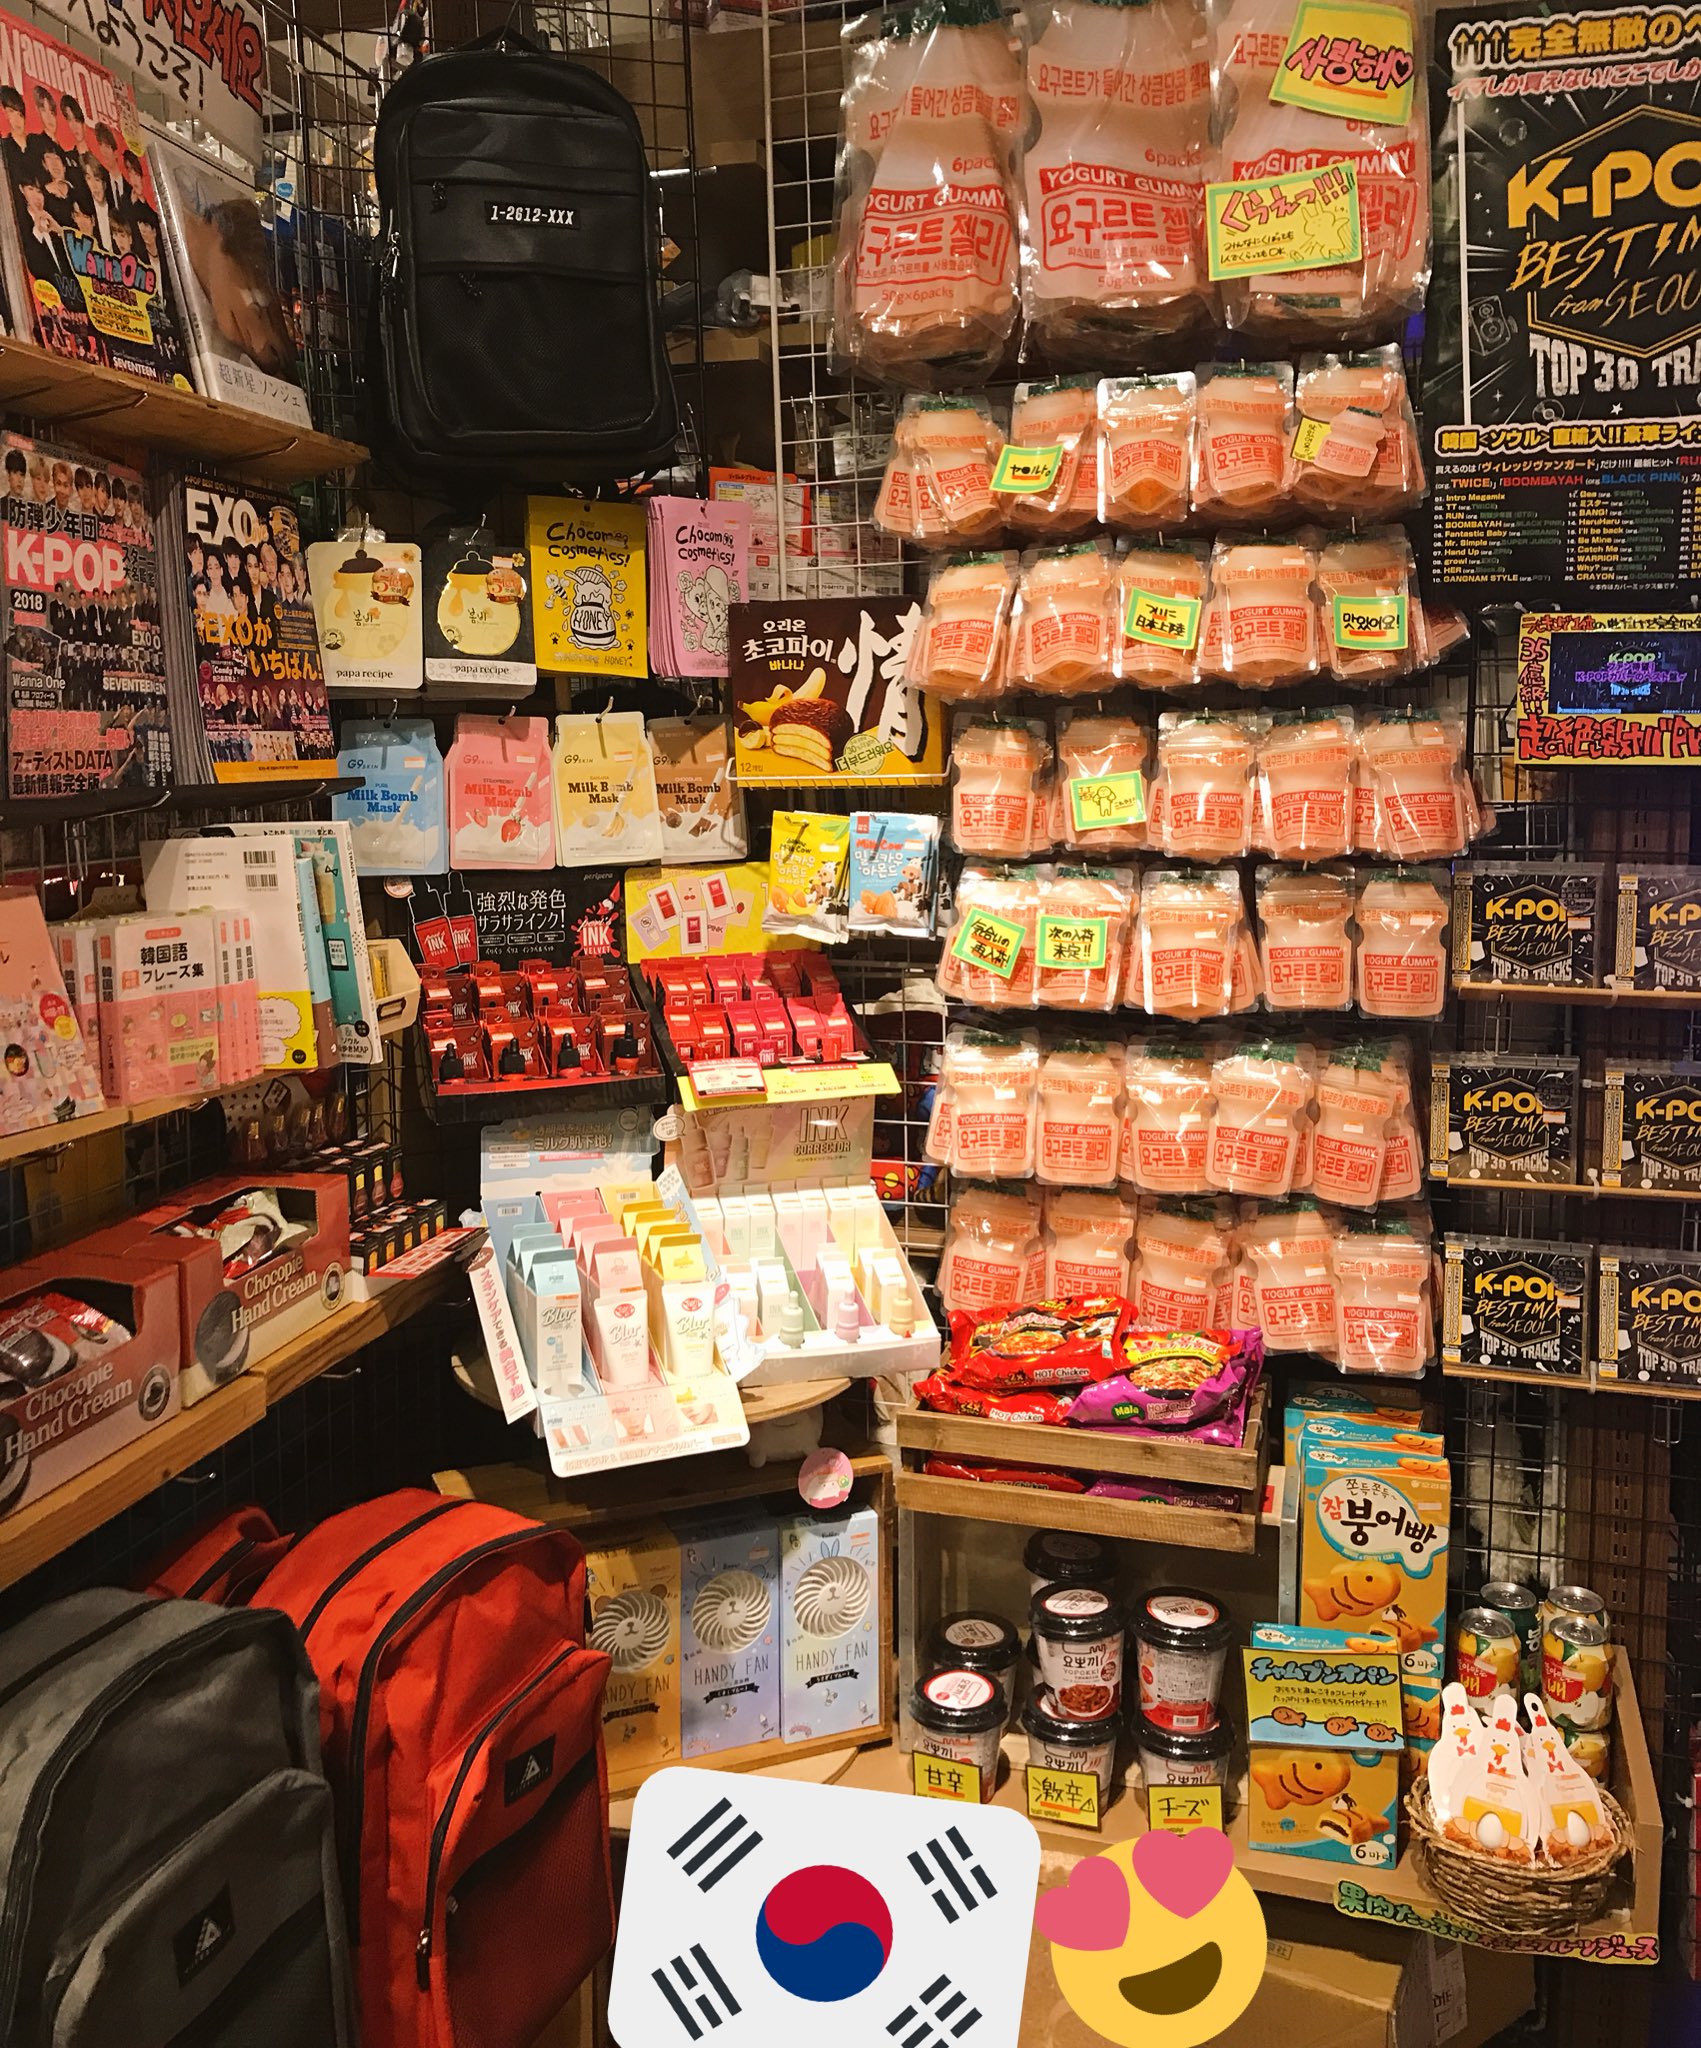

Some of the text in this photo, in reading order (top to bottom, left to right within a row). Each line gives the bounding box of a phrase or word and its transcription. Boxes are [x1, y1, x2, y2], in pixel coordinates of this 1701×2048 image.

[1046, 168, 1128, 190] YOGURT
[934, 186, 1006, 210] GUMMY
[490, 204, 574, 225] 1-2612-XXX
[1050, 197, 1155, 247] 요구르트
[950, 212, 1000, 268] 젤리
[1506, 223, 1658, 292] BEST
[1550, 294, 1600, 318] from
[112, 356, 157, 378] SEVENTEEN
[1529, 332, 1588, 398] TOP
[1593, 349, 1639, 392] 30
[9, 498, 98, 543] 防弾少年団
[7, 529, 127, 595] K-POP
[14, 591, 43, 611] 2018
[573, 609, 613, 631] HONEY
[1233, 606, 1305, 618] YOGURT GUMMY
[763, 618, 807, 635] 오리온
[1234, 619, 1305, 644] 요구르트 젤리
[742, 636, 834, 663] 초코파이
[249, 650, 323, 681] いちばん!
[336, 669, 394, 679] papa recipe
[454, 664, 510, 675] papa recipe
[769, 658, 806, 672] 바나나
[12, 673, 66, 690] Wanna One
[12, 750, 114, 772] アーティストDATA
[347, 789, 418, 802] Milk Bomb
[464, 783, 496, 796] Milk
[567, 781, 598, 793] Milk
[656, 782, 721, 794] Milk Bomb
[367, 801, 401, 814] Mask
[484, 796, 517, 809] Mask
[588, 793, 620, 804] Mask
[675, 794, 706, 805] Mask
[476, 889, 566, 913] 強烈な発色
[478, 908, 566, 934] サラサラインク!
[582, 925, 610, 946] INK
[1485, 923, 1528, 941] BEST
[140, 942, 189, 966] 韓国語
[1272, 948, 1341, 958] YOGURT GUMMY
[1518, 941, 1564, 957] SEOUL
[1401, 957, 1435, 966] GUMMY
[1490, 957, 1572, 981] TOP 30 TRACKS
[143, 962, 205, 984] フレーズ集
[1273, 963, 1340, 983] 요구르트 젤리
[1367, 972, 1434, 993] 요구르트 젤리
[801, 1104, 849, 1141] INK
[961, 1114, 1026, 1124] YOGURT GUMMY
[1463, 1115, 1507, 1134] BEST
[793, 1141, 851, 1154] CORRECTOR
[960, 1128, 1025, 1150] 요구르트 젤리
[1495, 1133, 1542, 1148] SEOUL
[1469, 1147, 1549, 1172] TOP 30 TRACKS
[243, 1252, 304, 1300] Chocopie
[955, 1256, 1018, 1276] YOGURT GUMMY
[953, 1273, 1016, 1299] 요구르트 젤리
[230, 1270, 318, 1334] Hand Cream
[1474, 1299, 1524, 1318] BEST
[541, 1306, 576, 1328] Blur
[677, 1315, 709, 1336] Blur
[1507, 1318, 1553, 1335] SEOUL
[609, 1324, 642, 1345] Blur
[1479, 1332, 1561, 1362] TOP 30 TRACKS
[1033, 1366, 1091, 1379] HOT Chicken
[25, 1360, 114, 1421] Chocopie
[4, 1377, 133, 1464] Hand Cream
[989, 1408, 1045, 1422] HOT Chicken
[1114, 1404, 1140, 1416] Mala
[1322, 1495, 1344, 1521] 참
[1340, 1498, 1437, 1554] 붕어빵
[796, 1641, 869, 1672] HANDY FAN
[1063, 1655, 1099, 1667] 요뽀끼
[693, 1654, 769, 1686] HANDY FAN
[1158, 1796, 1209, 1818] チーズ
